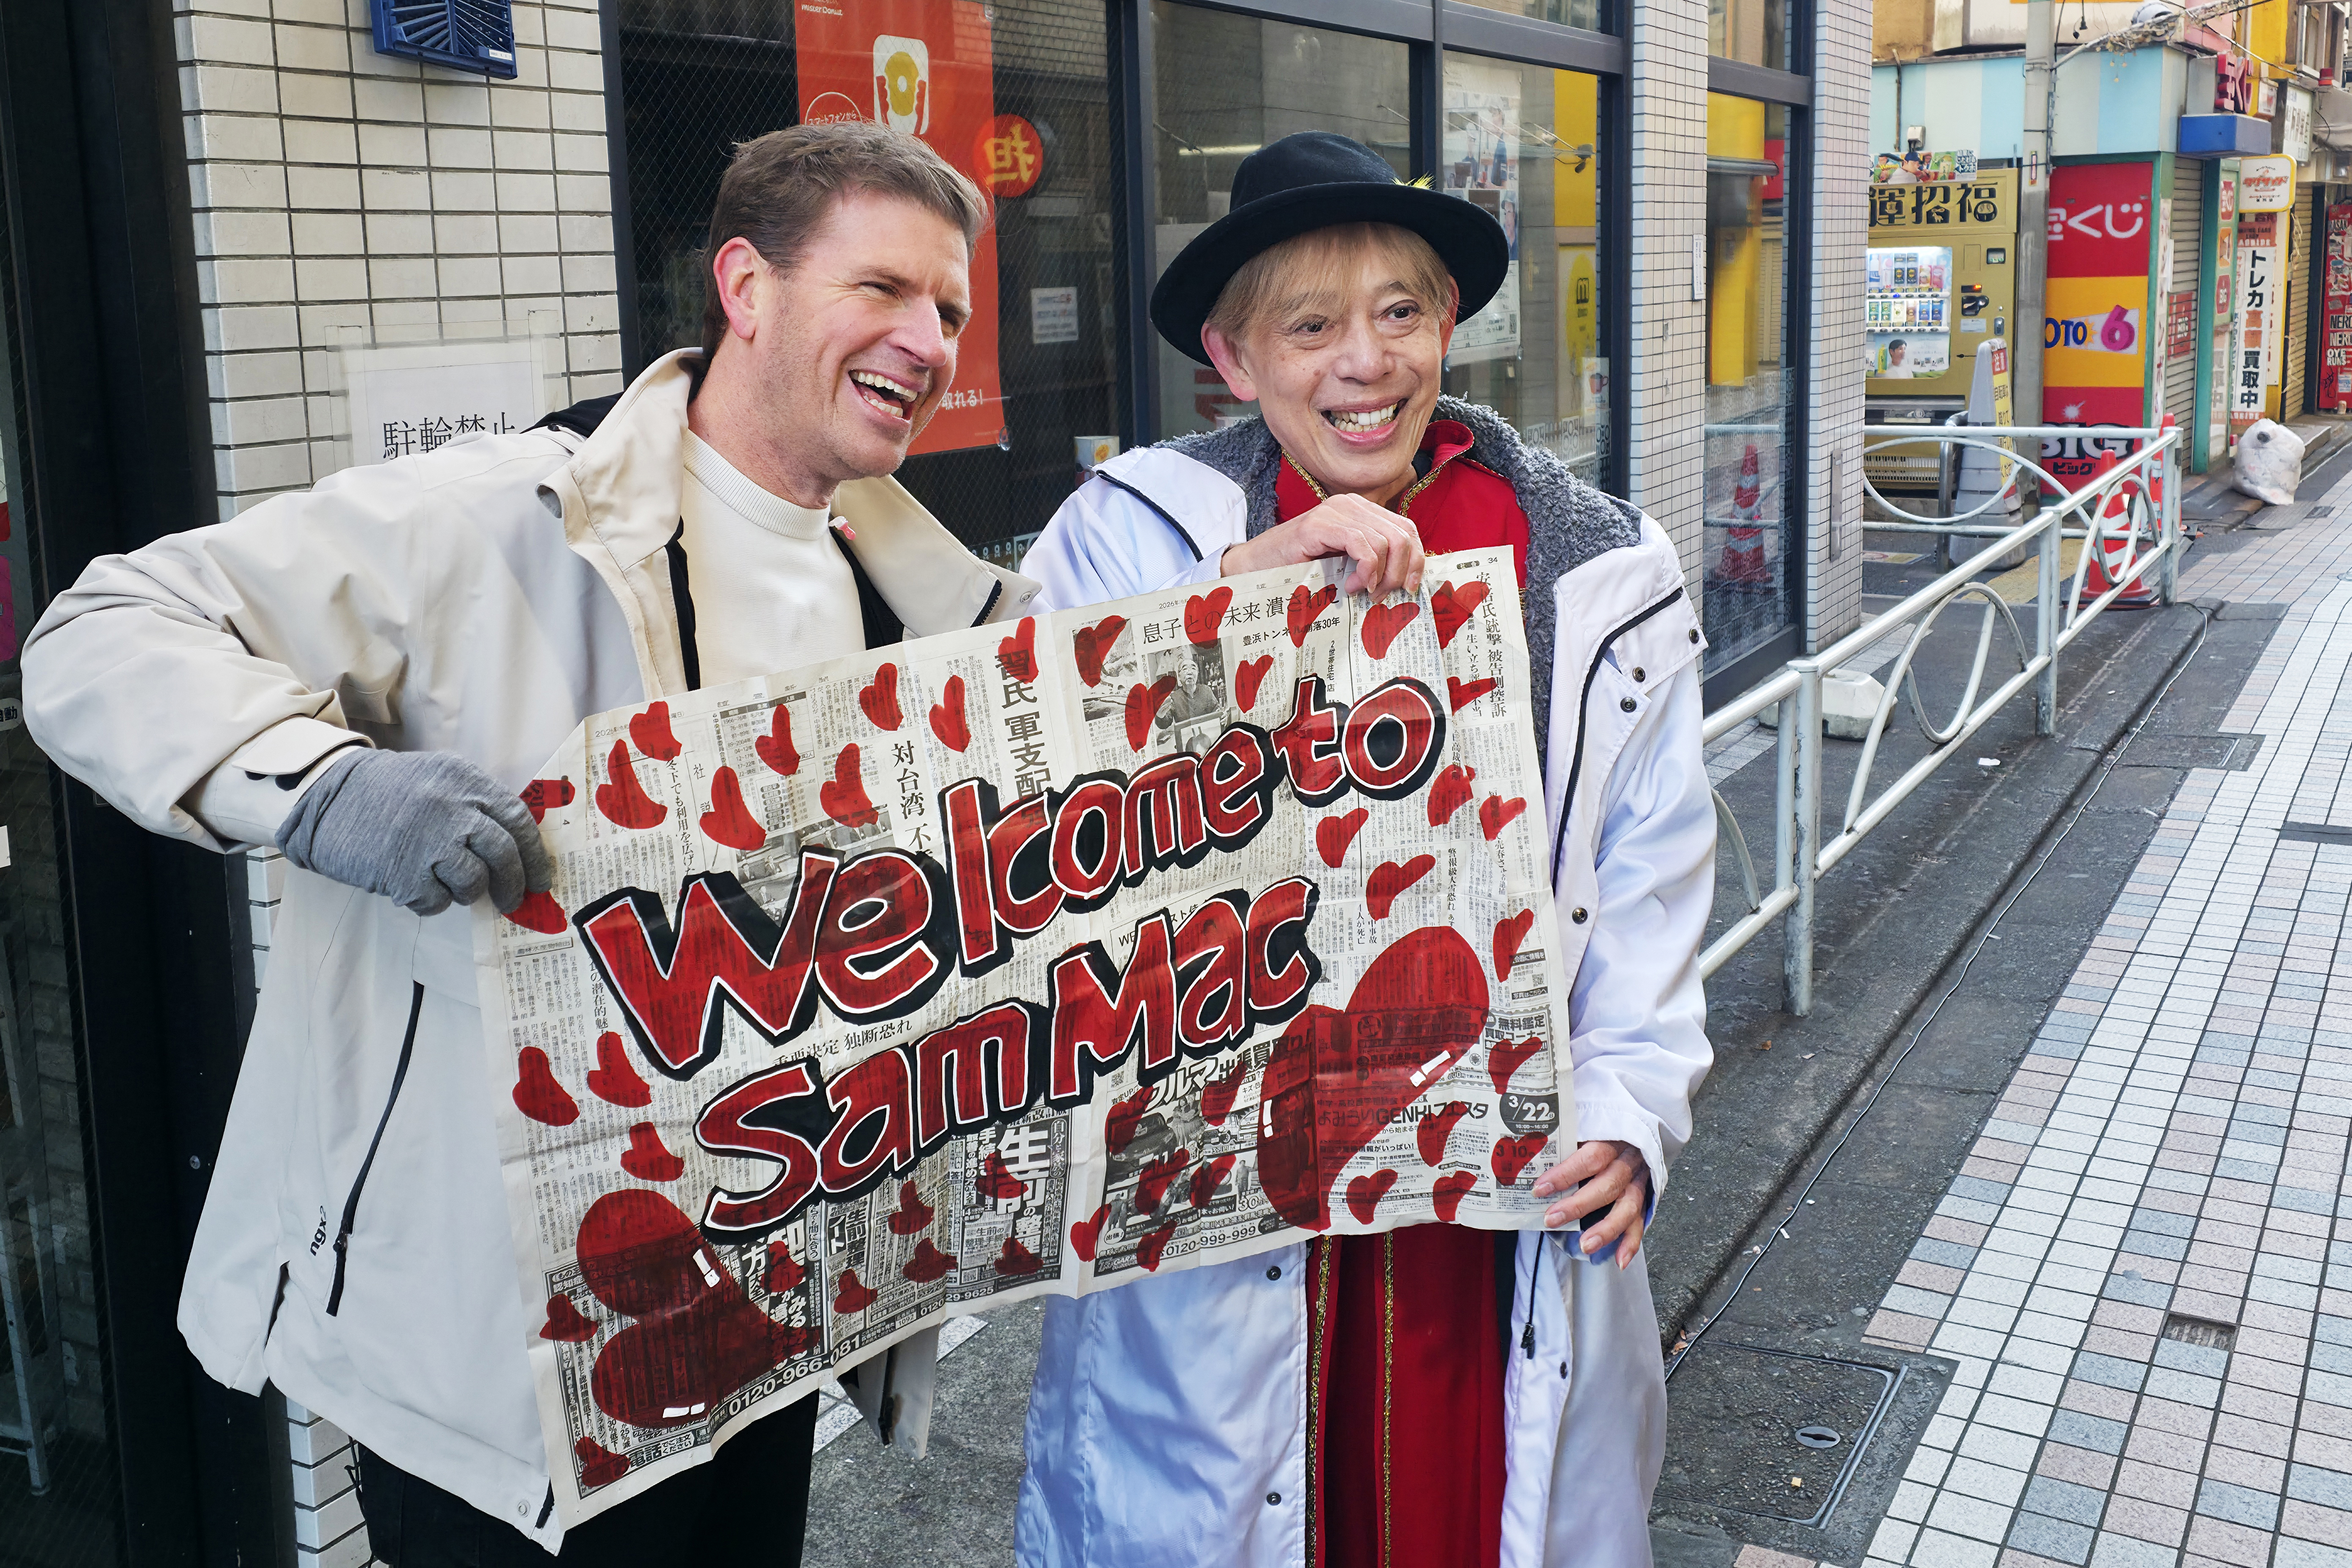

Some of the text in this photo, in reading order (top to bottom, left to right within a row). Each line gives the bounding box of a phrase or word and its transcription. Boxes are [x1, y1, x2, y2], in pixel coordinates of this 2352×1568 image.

[801, 4, 842, 15] Mister Donut
[1869, 183, 1997, 227] 運招福
[2101, 304, 2135, 352] 6
[2053, 461, 2096, 475] ビッグ
[1143, 603, 1261, 644] 息子との未来
[890, 740, 926, 820] 対台湾
[576, 719, 1273, 1079] Welcome
[1271, 674, 1448, 807] to
[1356, 903, 1365, 944] 4人が死亡
[844, 1020, 912, 1050] 独断恐れ
[1485, 1030, 1546, 1041] 買取コーナー
[1498, 1014, 1545, 1031] 無料鑑定
[694, 995, 1053, 1241] Sam
[1047, 875, 1321, 1110] Mac
[1508, 1095, 1550, 1121] 3/22
[829, 1215, 846, 1255] ノート
[846, 1207, 866, 1267] 生前整理
[1166, 1225, 1256, 1257] 0120-999-999
[728, 1335, 861, 1416] 0120-966-081
[628, 1444, 662, 1469] 電話
